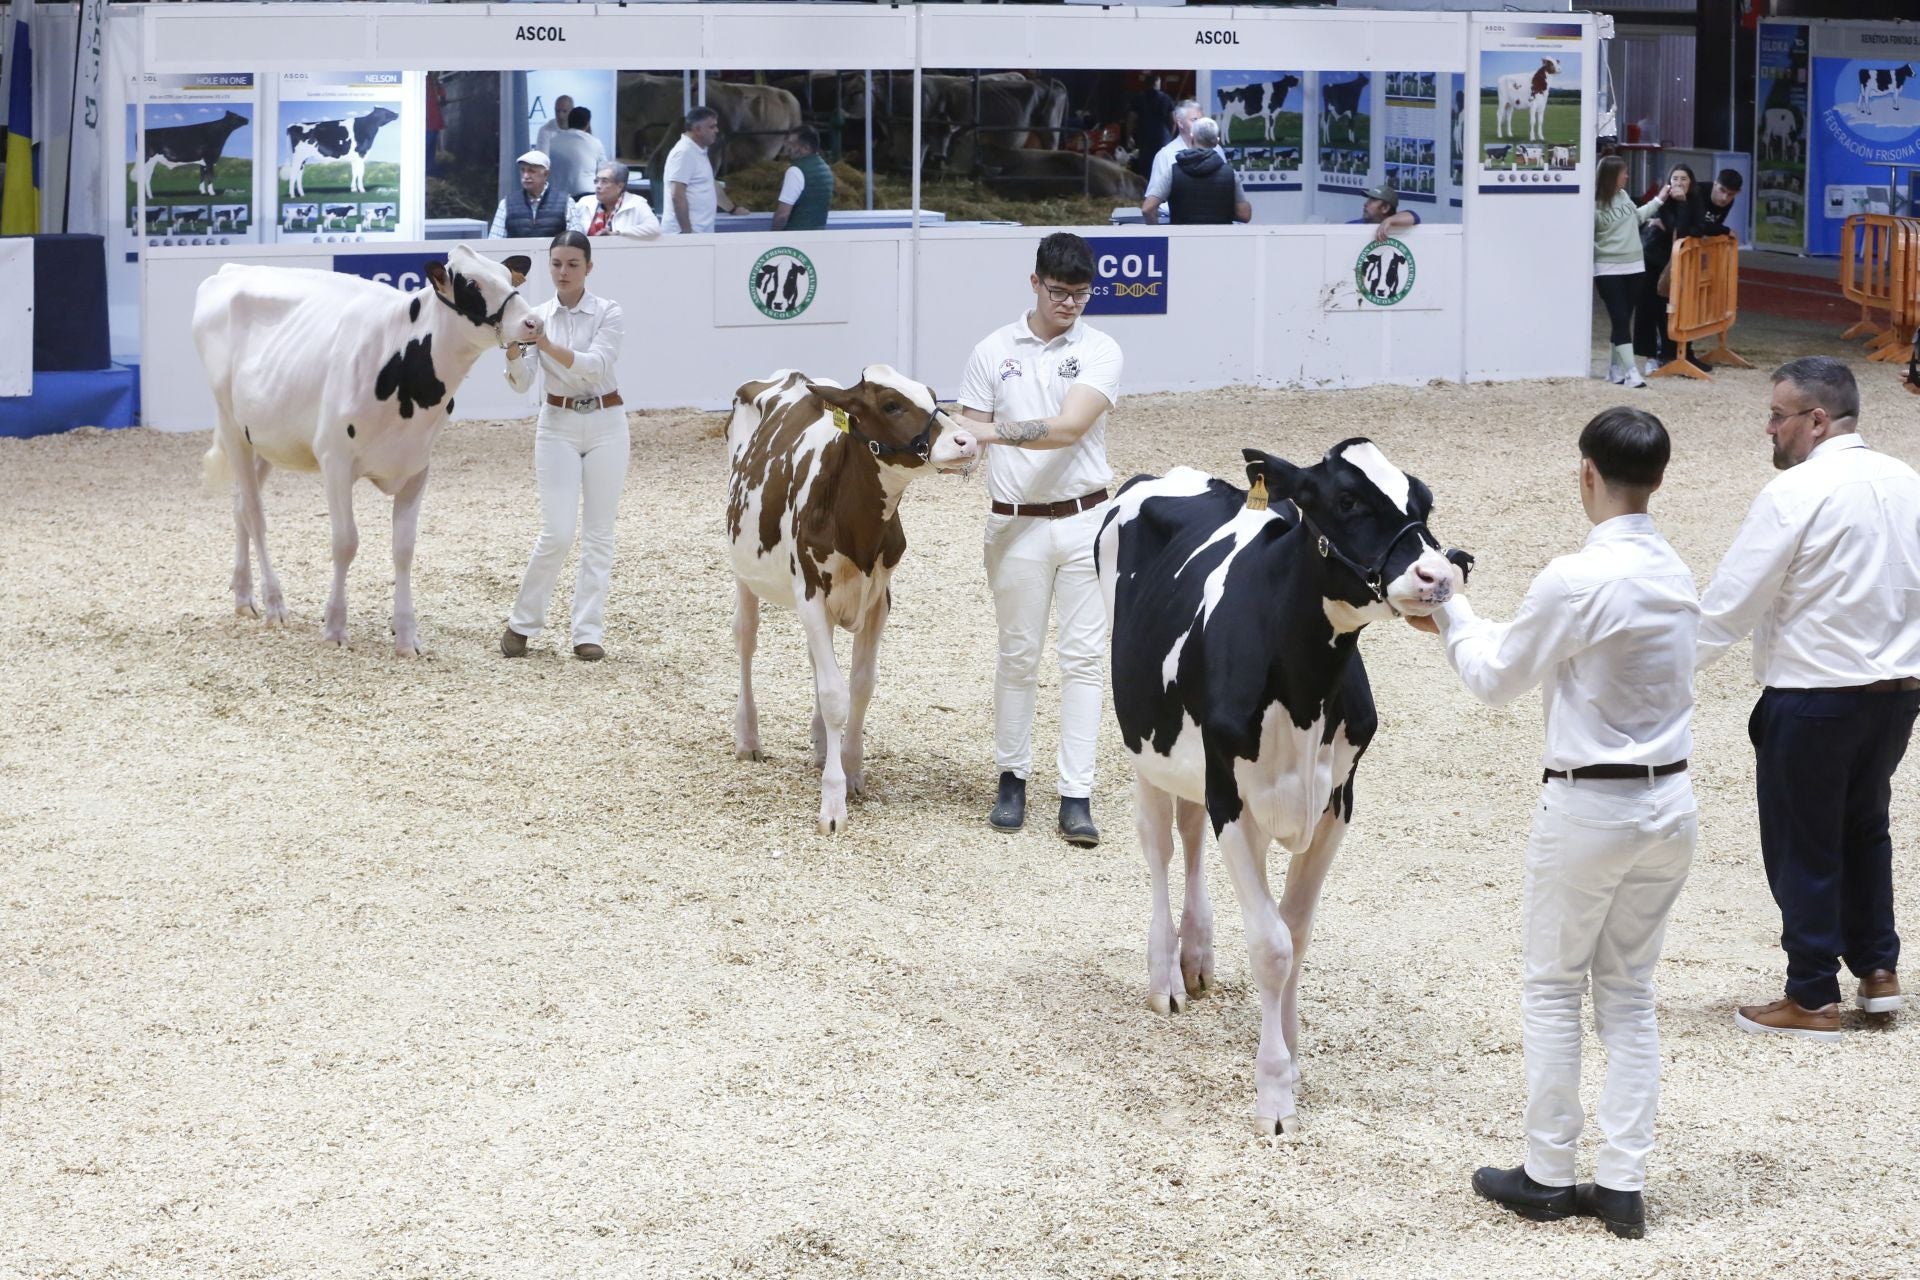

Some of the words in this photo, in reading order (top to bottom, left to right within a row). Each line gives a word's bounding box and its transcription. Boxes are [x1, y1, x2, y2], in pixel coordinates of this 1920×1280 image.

[515, 26, 566, 42] ASCOL
[1195, 30, 1240, 45] ASCOL
[195, 77, 219, 85] HOLE
[220, 77, 228, 85] IN
[228, 76, 248, 85] ONE
[364, 74, 398, 83] NELSON
[1823, 108, 1874, 160] FEDERACIÓN
[1875, 144, 1916, 161] FRISONA
[1098, 254, 1163, 278] COL
